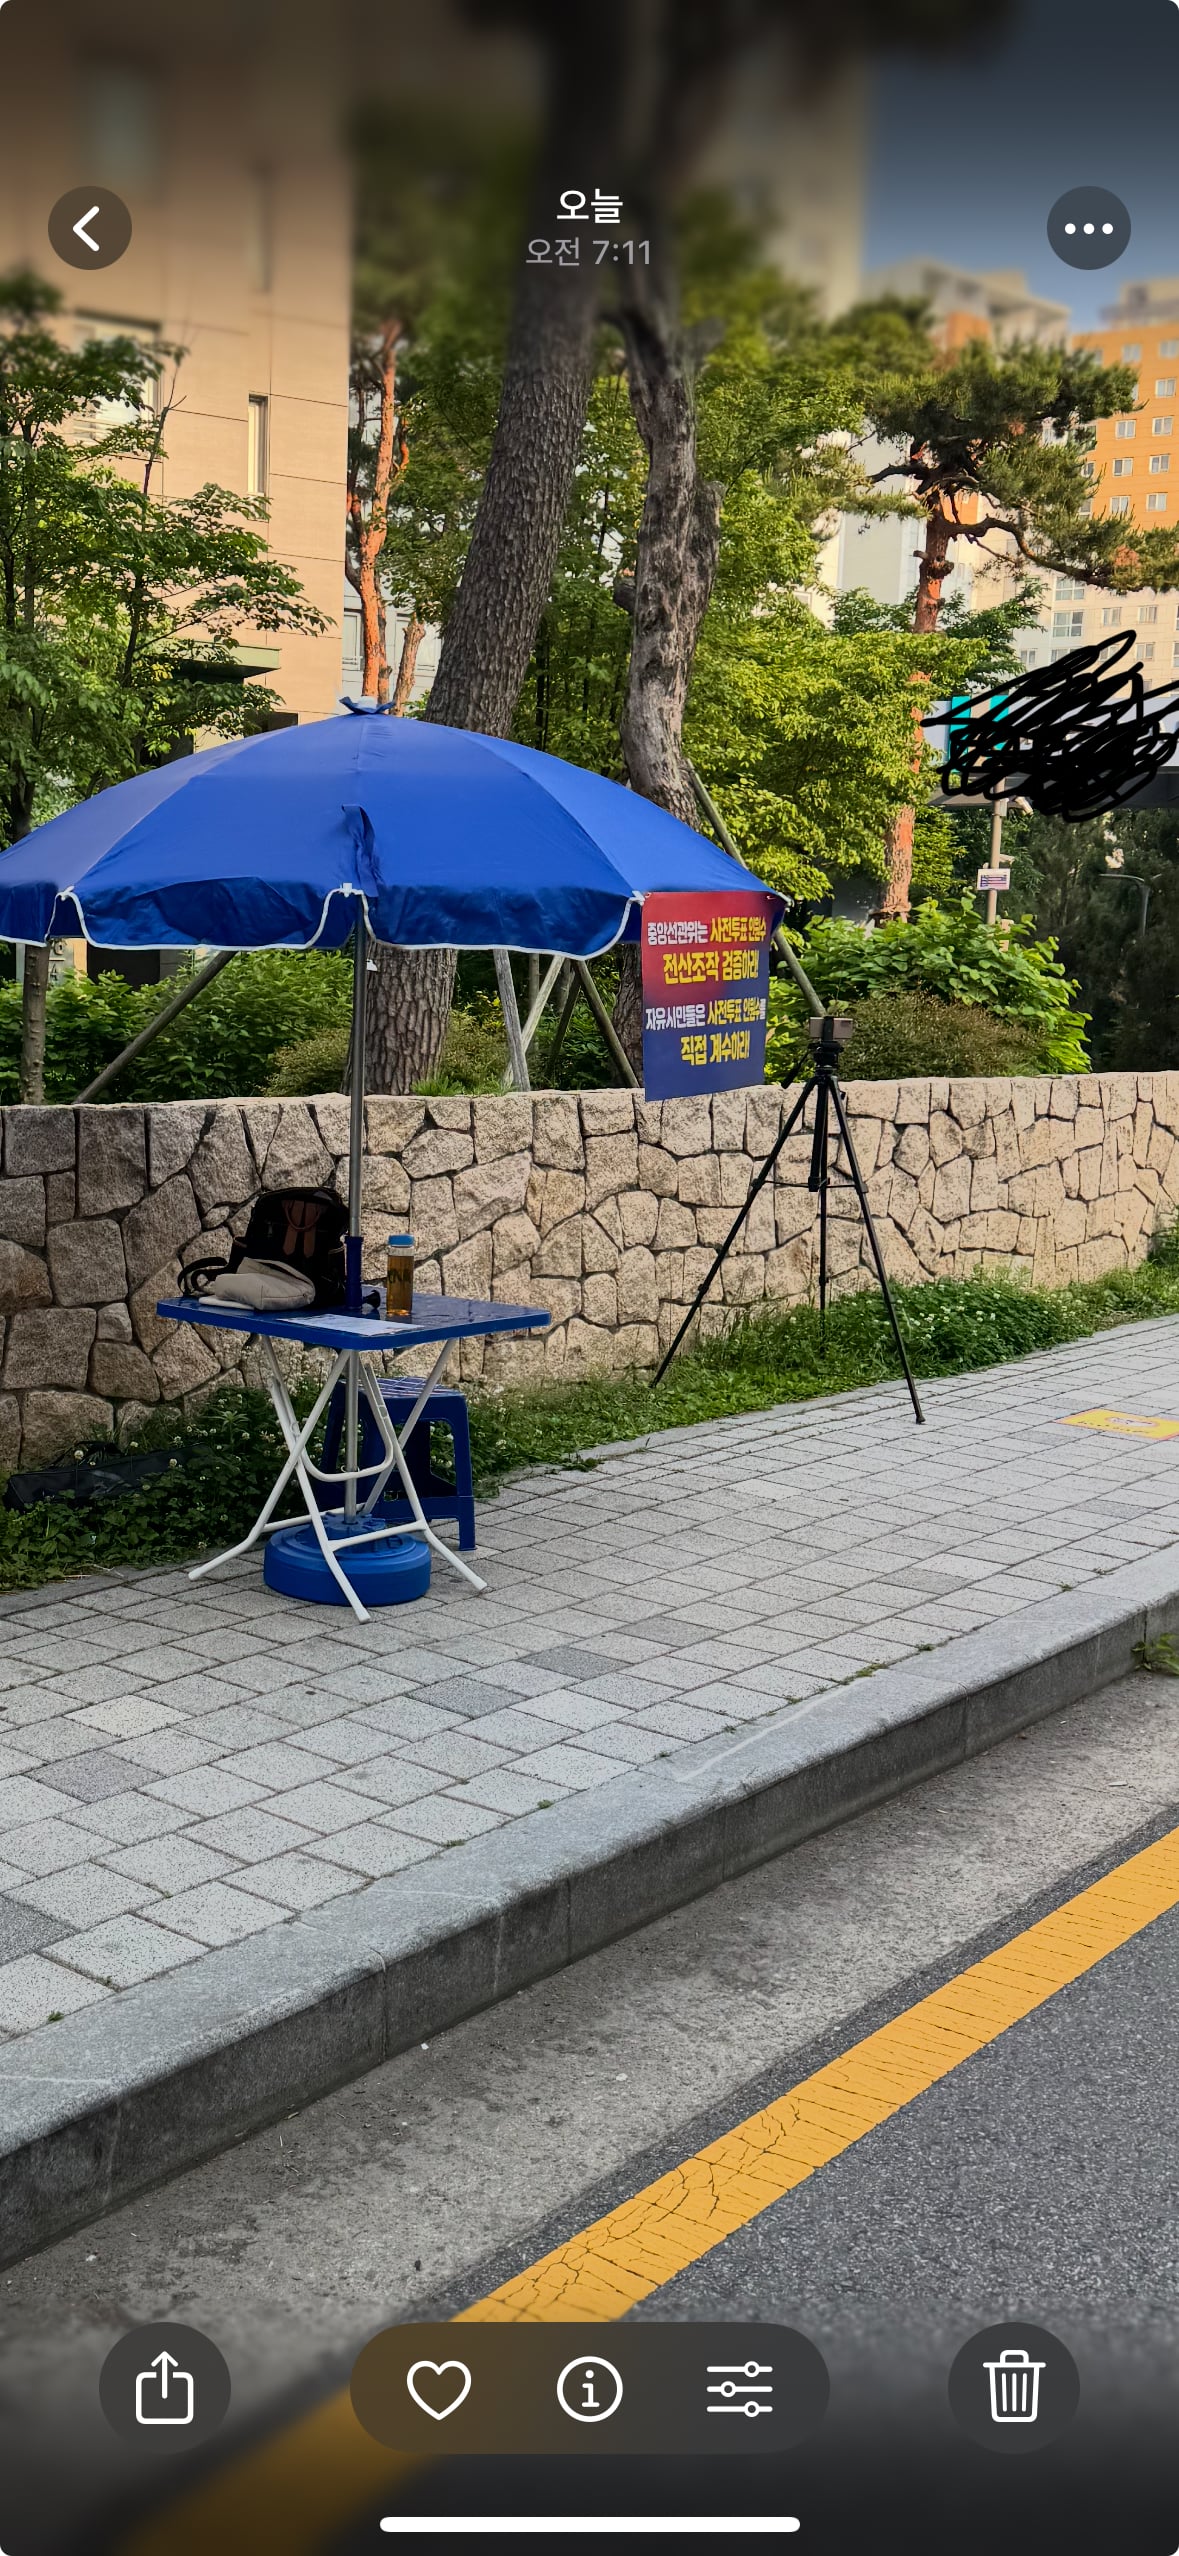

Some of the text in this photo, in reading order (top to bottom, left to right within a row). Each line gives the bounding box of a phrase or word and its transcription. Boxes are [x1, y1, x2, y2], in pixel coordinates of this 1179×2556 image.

[648, 920, 708, 945] 중앙선관위는
[710, 917, 748, 943] 사전투표
[663, 951, 720, 985] 전산조작
[645, 1003, 706, 1031] 자유시민들은
[707, 998, 743, 1025] 사전투표
[681, 1034, 707, 1066] 직접
